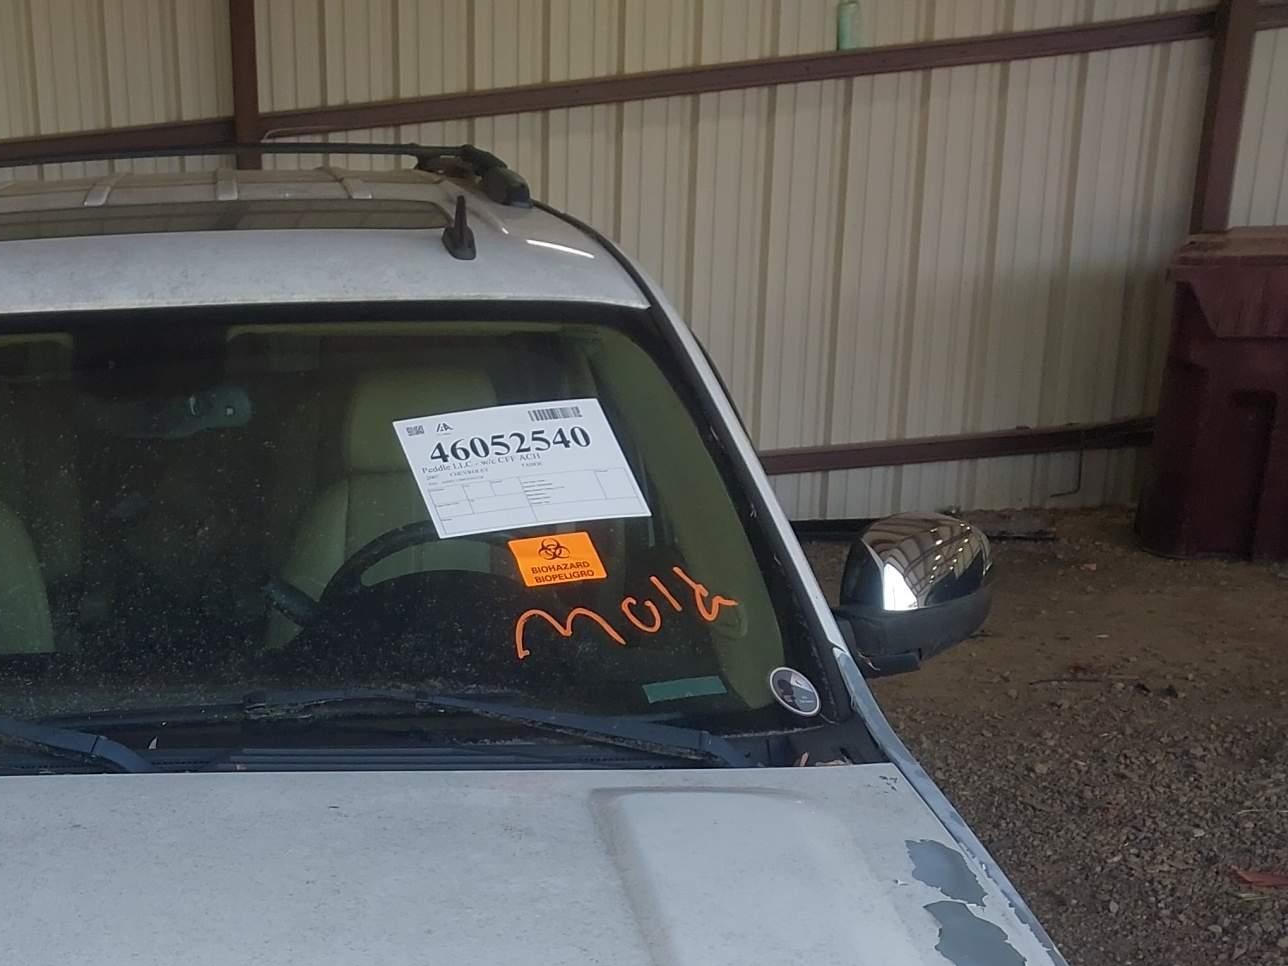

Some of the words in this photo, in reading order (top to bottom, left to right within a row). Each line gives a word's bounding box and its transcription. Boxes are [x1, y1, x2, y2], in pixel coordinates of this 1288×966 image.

[429, 425, 591, 463] 46052540
[422, 464, 451, 474] Peddle
[531, 560, 591, 575] BIOHAZARD
[534, 569, 595, 584] BIOPELIGRO
